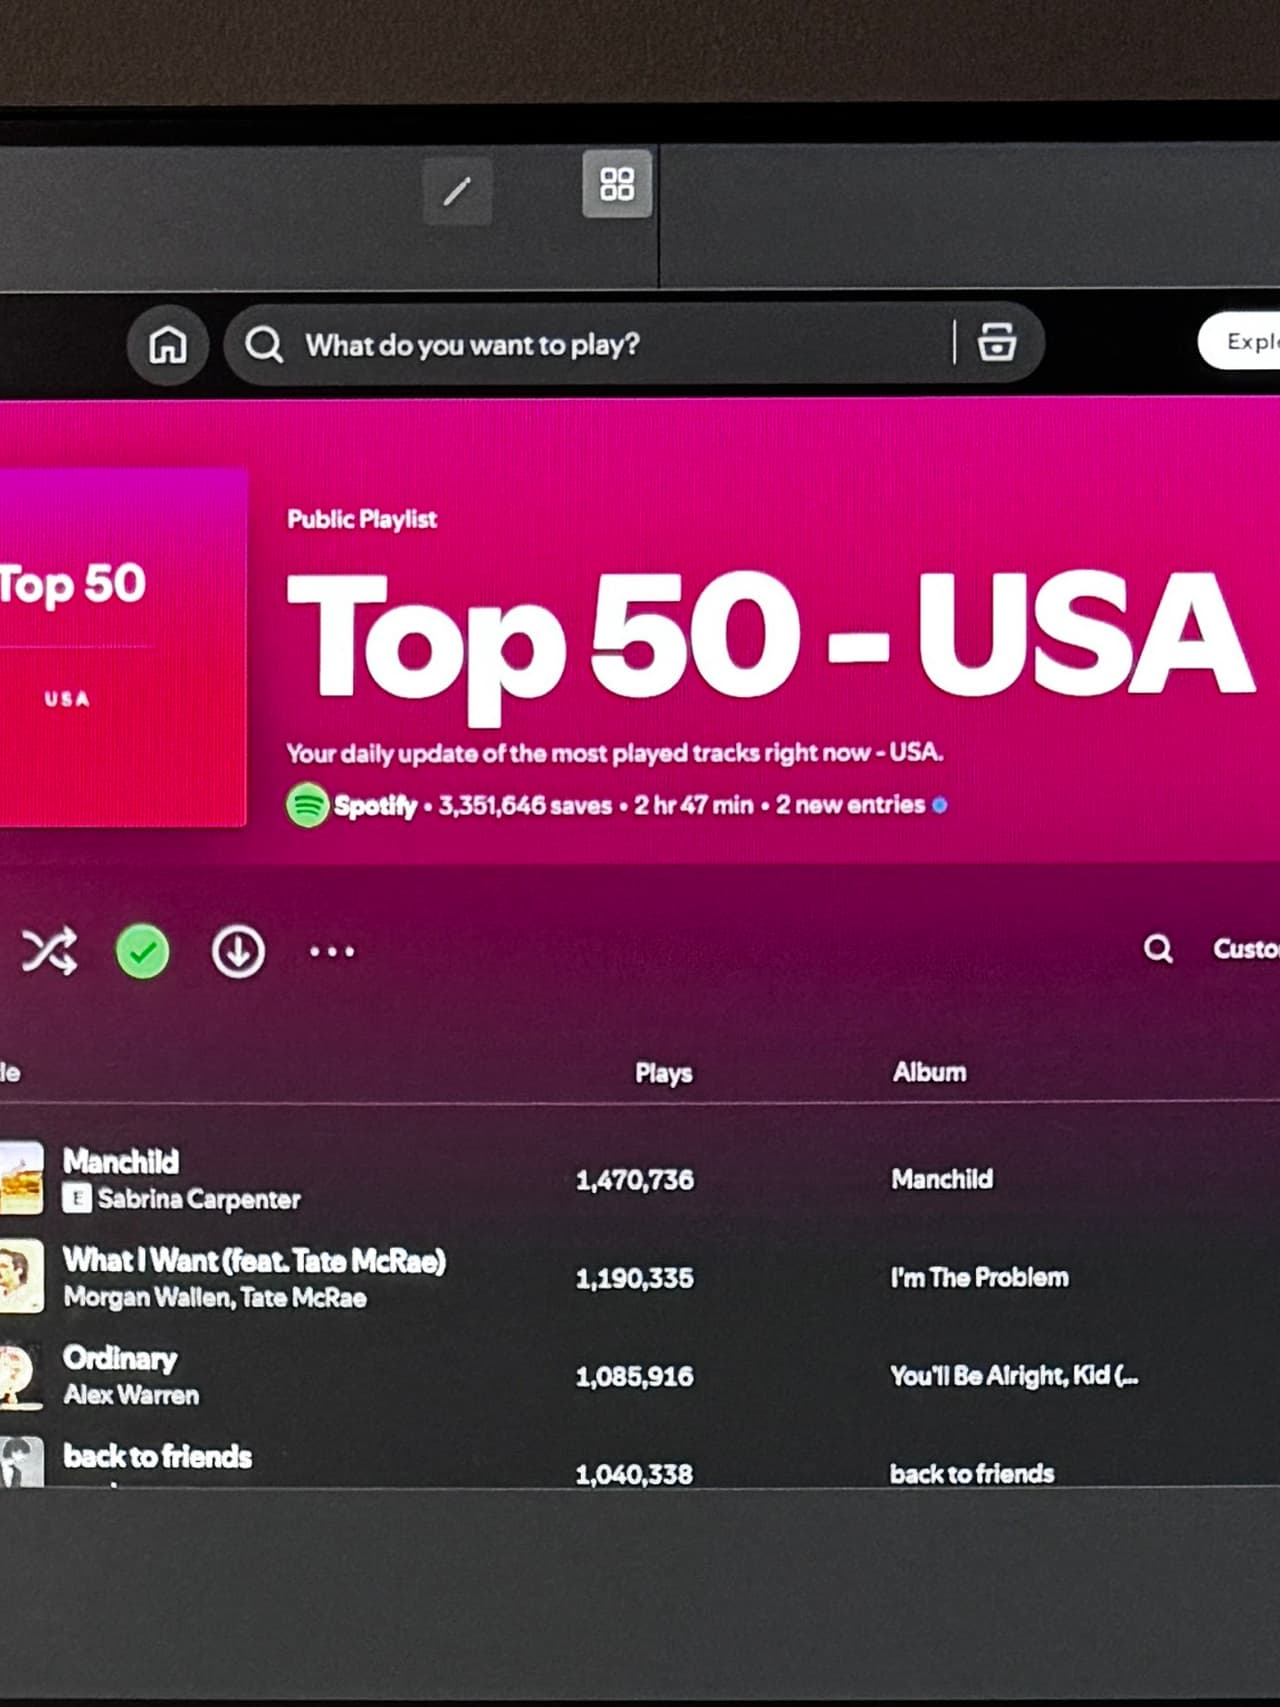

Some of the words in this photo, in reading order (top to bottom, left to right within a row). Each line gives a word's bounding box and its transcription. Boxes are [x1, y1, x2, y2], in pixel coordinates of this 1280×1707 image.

[305, 333, 375, 357] What
[379, 333, 413, 356] do
[419, 336, 464, 362] you
[470, 335, 535, 356] want
[539, 334, 565, 356] to
[571, 332, 640, 361] play?
[287, 508, 355, 529] Public
[358, 508, 438, 532] Playlist
[84, 562, 146, 603] 50
[287, 574, 567, 728] Top
[591, 569, 800, 698] 50
[919, 569, 1257, 698] USA
[44, 690, 90, 708] USA
[287, 743, 337, 765] Your
[341, 743, 394, 768] daily
[398, 744, 477, 769] update
[482, 743, 508, 764] of
[509, 743, 548, 764] the
[551, 745, 608, 764] most
[612, 743, 687, 768] played
[692, 743, 761, 764] tracks
[765, 742, 819, 768] right
[823, 747, 872, 763] now
[889, 742, 944, 764] USA.
[333, 794, 418, 820] Spotify
[438, 794, 546, 818] 3,351,646
[550, 797, 613, 815] saves
[795, 798, 846, 814] new
[849, 794, 926, 815] entries
[635, 1062, 693, 1088] Plays
[893, 1061, 967, 1084] Album
[63, 1147, 180, 1176] Manchild
[576, 1168, 694, 1195] 1,470,736
[891, 1168, 993, 1191] Manchild
[98, 1188, 184, 1211] Sabrina
[187, 1188, 301, 1213] Carpenter
[63, 1246, 134, 1274] What
[151, 1247, 219, 1274] Want
[222, 1246, 291, 1277] (feat.
[293, 1248, 347, 1274] Tate
[350, 1246, 446, 1277] McRae)
[576, 1267, 694, 1293] 1,190,335
[891, 1266, 924, 1288] I'm
[929, 1266, 970, 1288] The
[975, 1266, 1069, 1289] Problem
[63, 1344, 177, 1377] Ordinary
[576, 1366, 694, 1391] 1,085,916
[890, 1365, 950, 1386] You'll
[954, 1365, 983, 1386] Be
[986, 1364, 1069, 1391] Alright,
[1074, 1364, 1110, 1385] Kid
[64, 1384, 113, 1407] Alex
[117, 1385, 199, 1407] Warren
[63, 1442, 127, 1469] back
[130, 1446, 159, 1469] to
[161, 1443, 253, 1470] friends
[576, 1462, 694, 1489] 1,040,338
